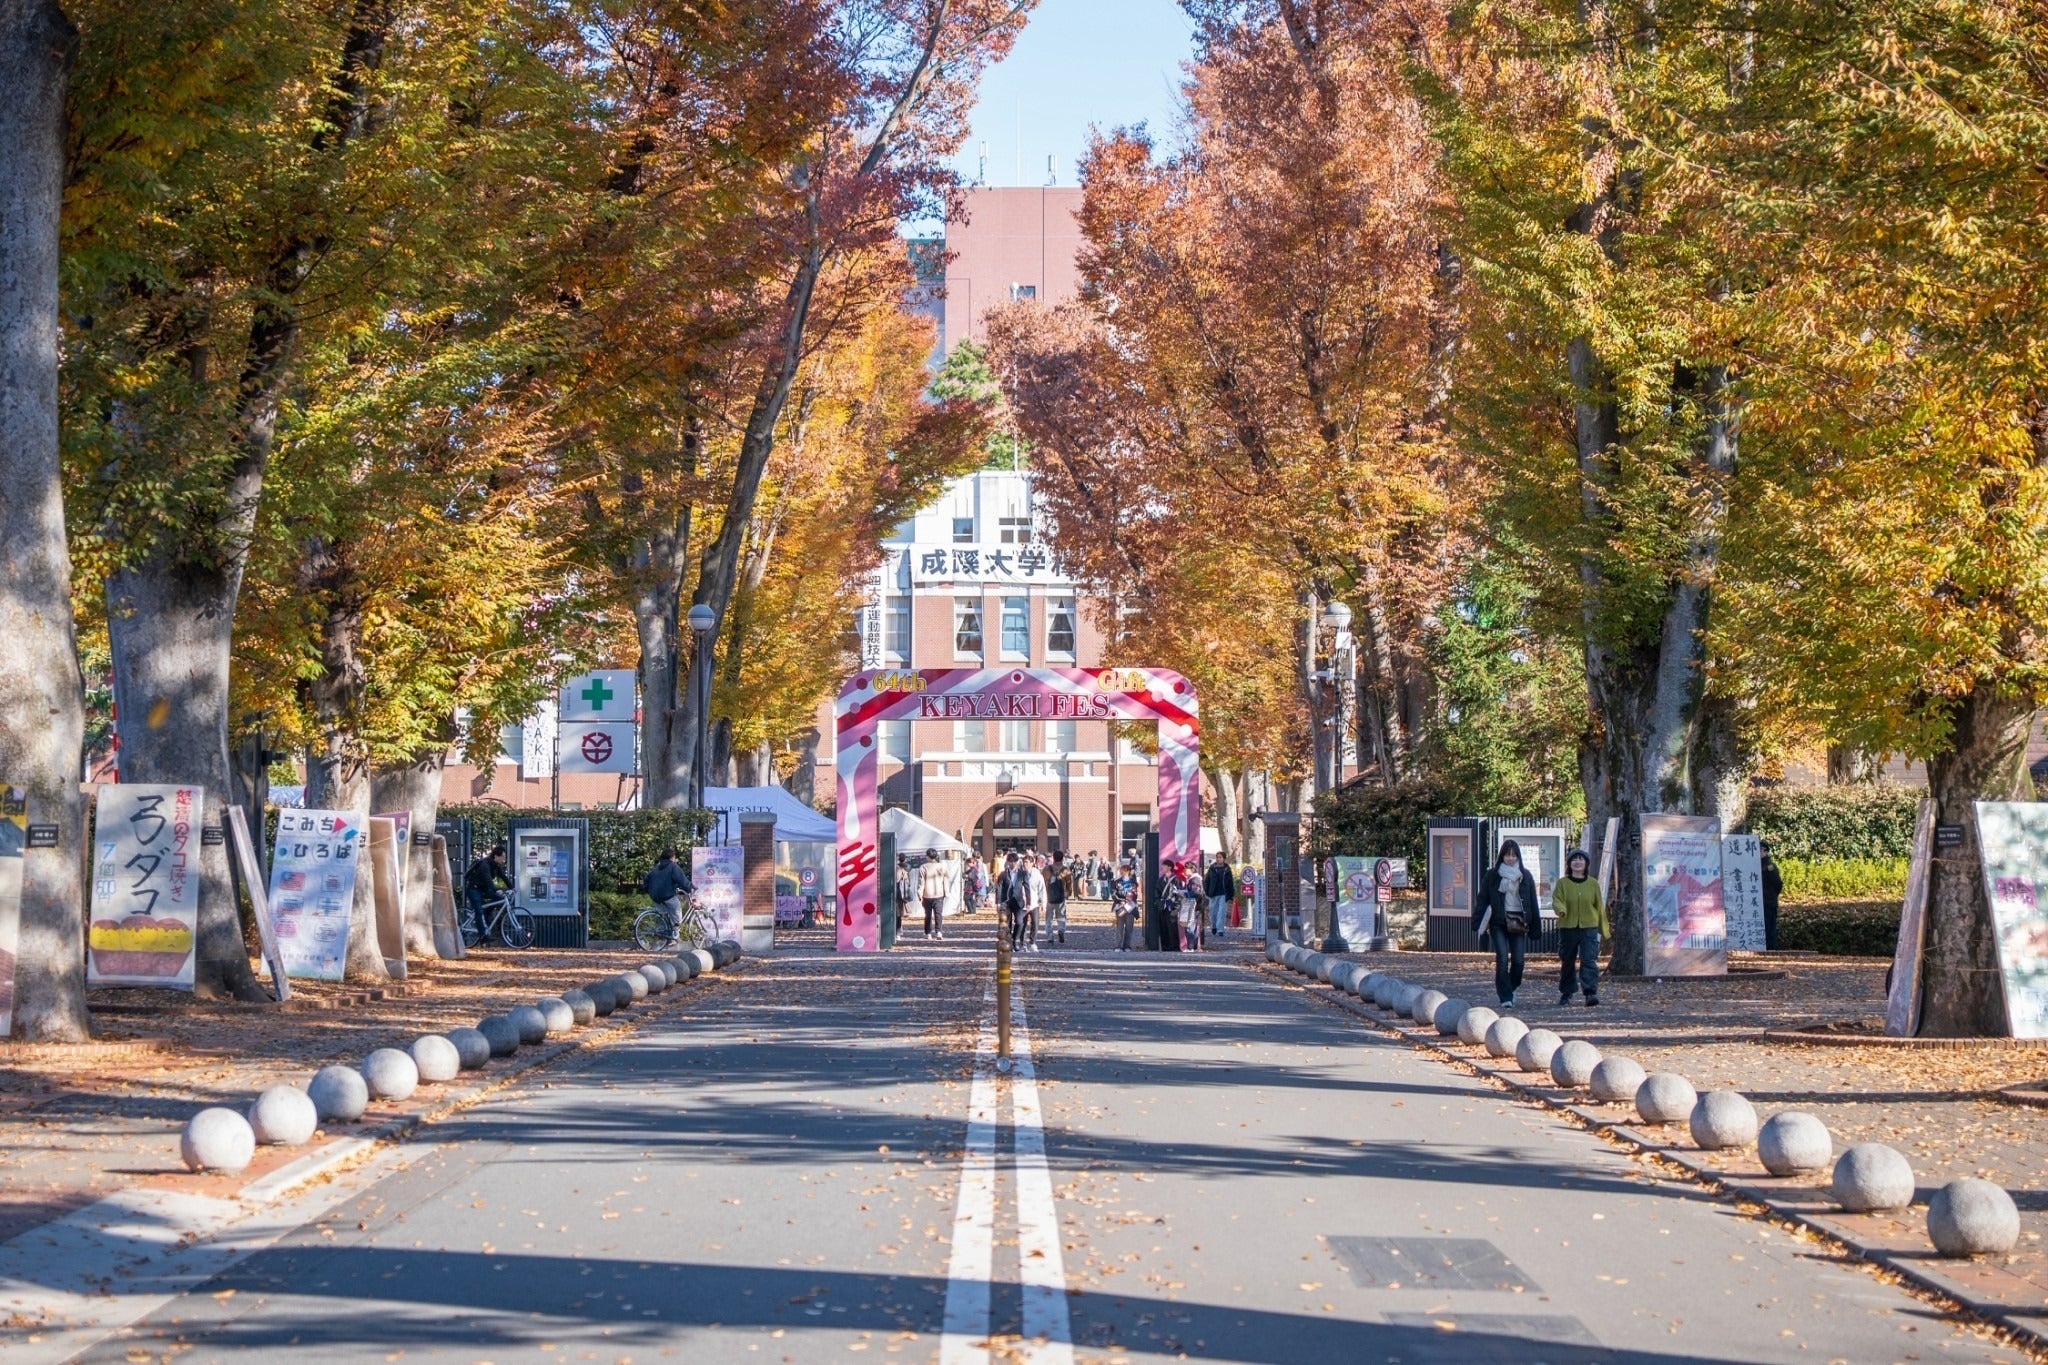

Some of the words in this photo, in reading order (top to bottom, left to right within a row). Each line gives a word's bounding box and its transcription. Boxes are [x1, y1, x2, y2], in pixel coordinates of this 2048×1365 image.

[872, 672, 926, 692] 64th
[1097, 671, 1146, 692] Gift
[919, 693, 1041, 718] KEYAKI
[1050, 693, 1118, 718] FES.
[282, 816, 334, 831] こみち
[294, 844, 352, 859] ひろば
[805, 871, 812, 881] 8
